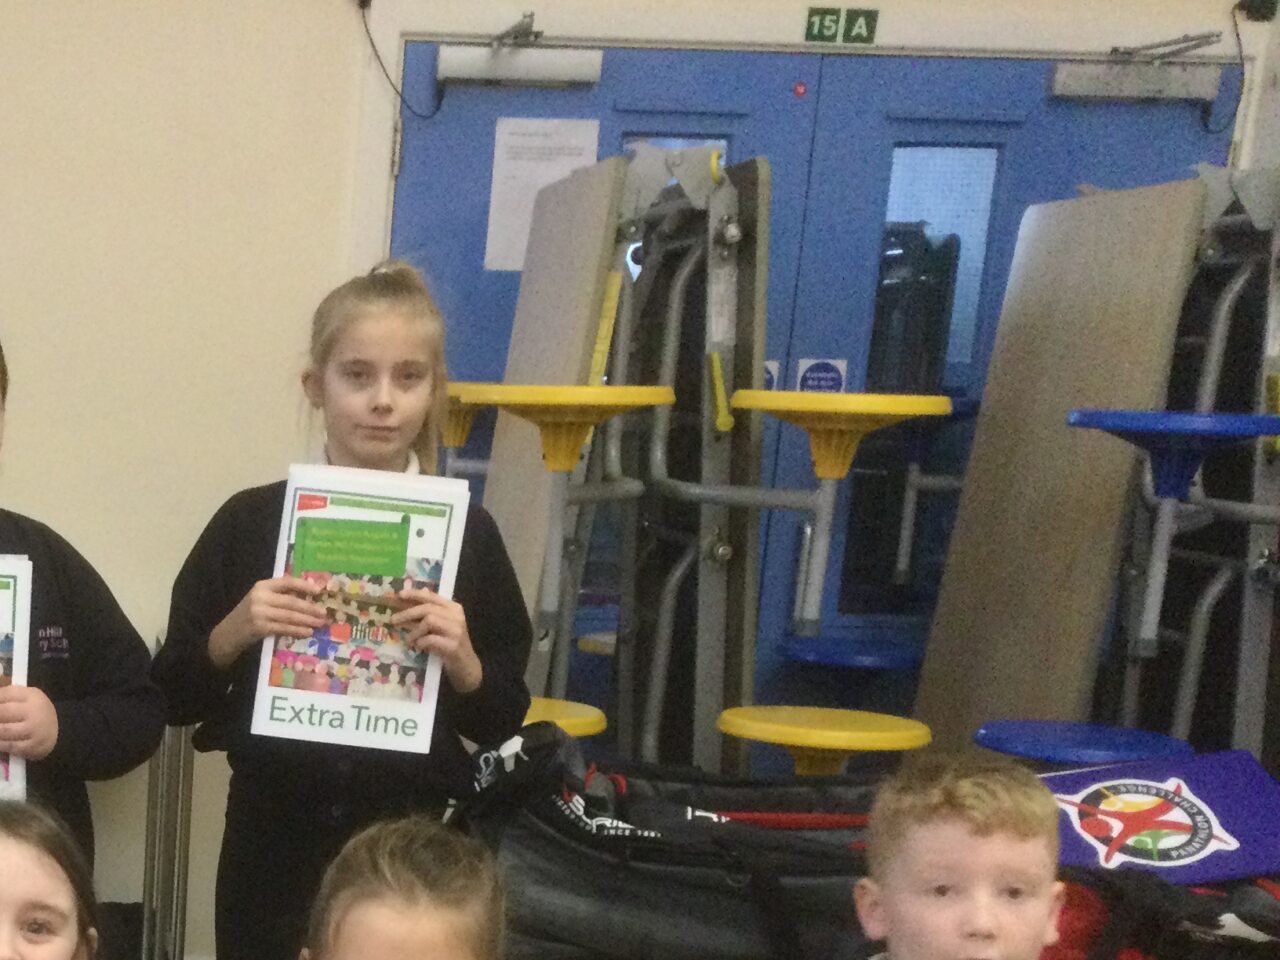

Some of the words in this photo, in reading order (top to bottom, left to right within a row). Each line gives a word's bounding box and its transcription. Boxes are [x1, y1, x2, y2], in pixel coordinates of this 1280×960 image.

[810, 14, 837, 37] 15
[850, 16, 868, 37] A
[269, 695, 345, 729] Extra
[350, 704, 418, 737] Time
